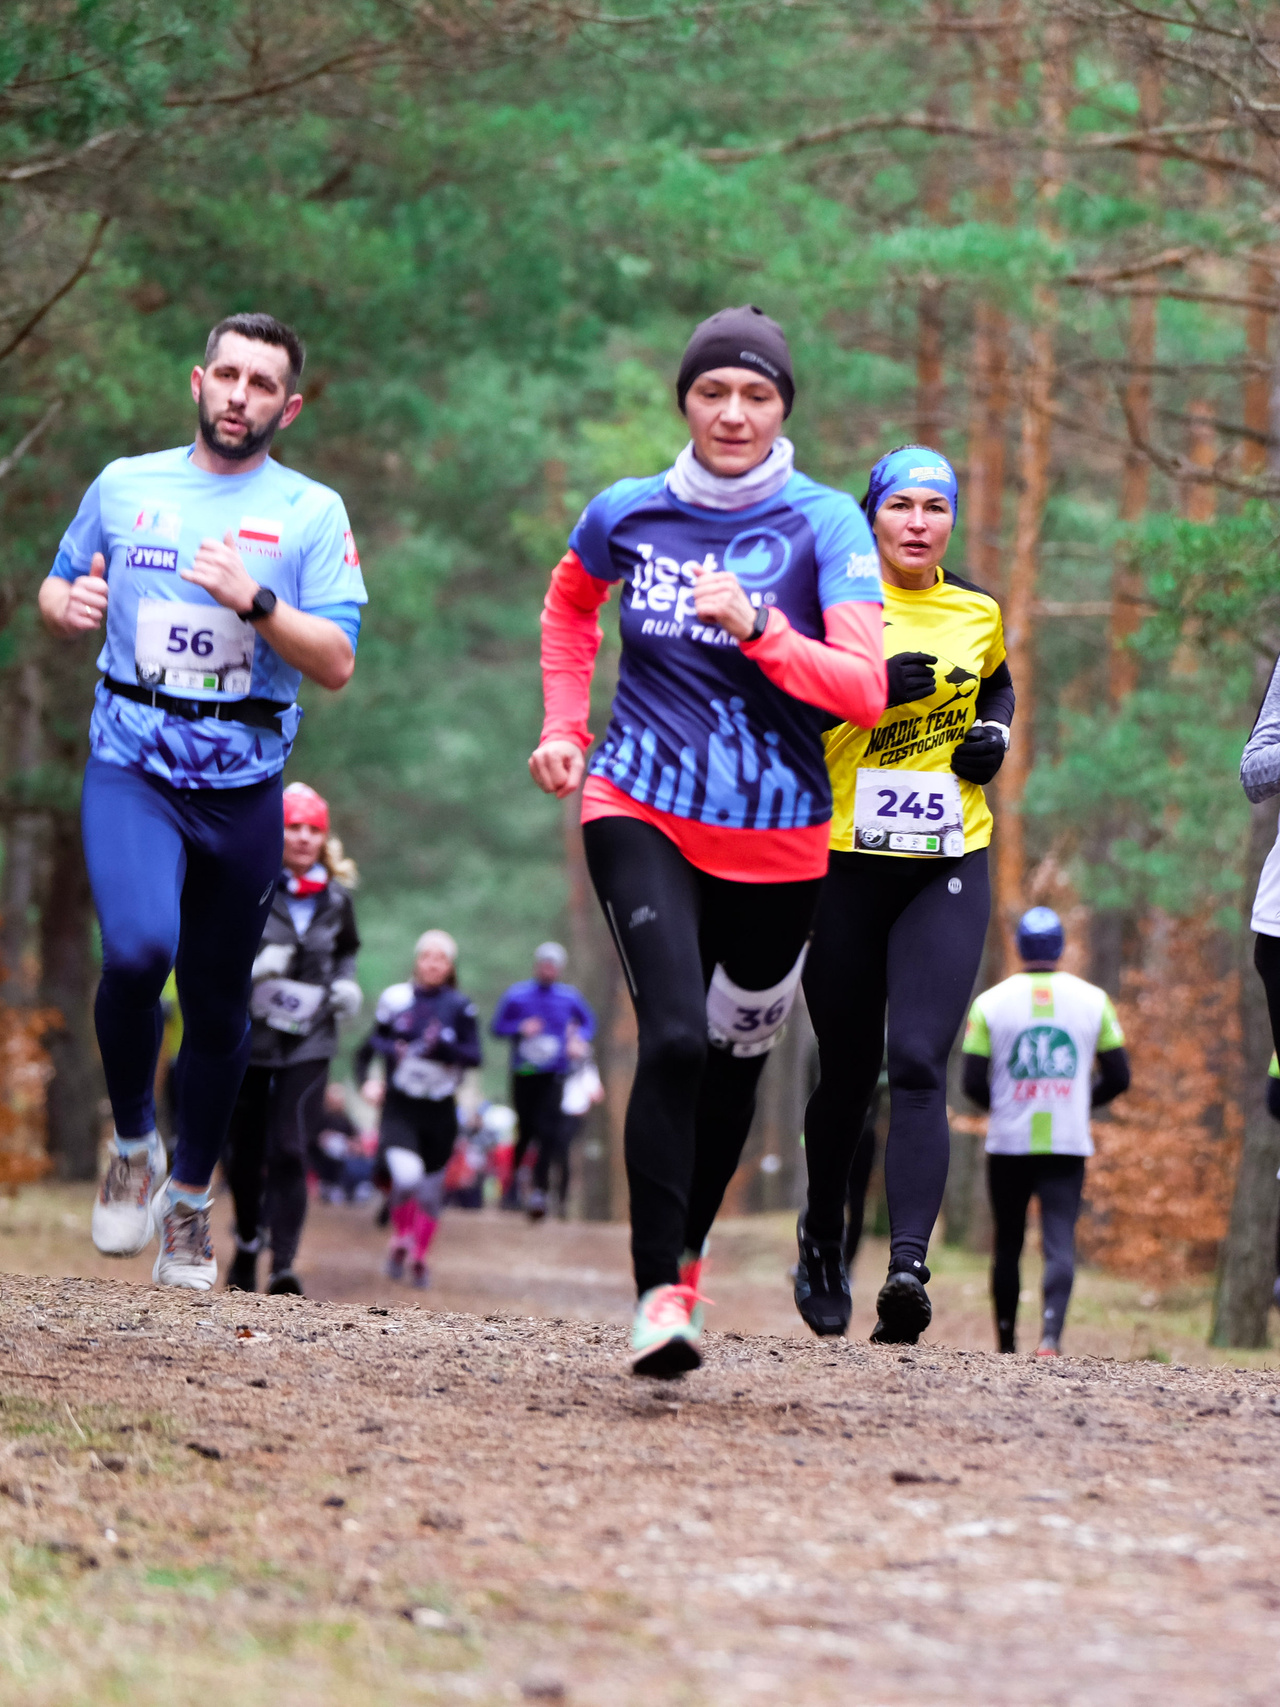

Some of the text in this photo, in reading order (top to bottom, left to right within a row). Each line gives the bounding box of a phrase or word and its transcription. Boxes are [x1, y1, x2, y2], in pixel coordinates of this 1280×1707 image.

[134, 547, 177, 569] JYSK
[234, 542, 283, 560] OLAND
[166, 625, 215, 657] 56
[641, 618, 685, 638] RUN
[863, 706, 969, 758] NORDIC TEAM
[879, 726, 966, 767] CZĘSTOCHOWA
[876, 789, 945, 821] 245
[732, 996, 785, 1032] 36
